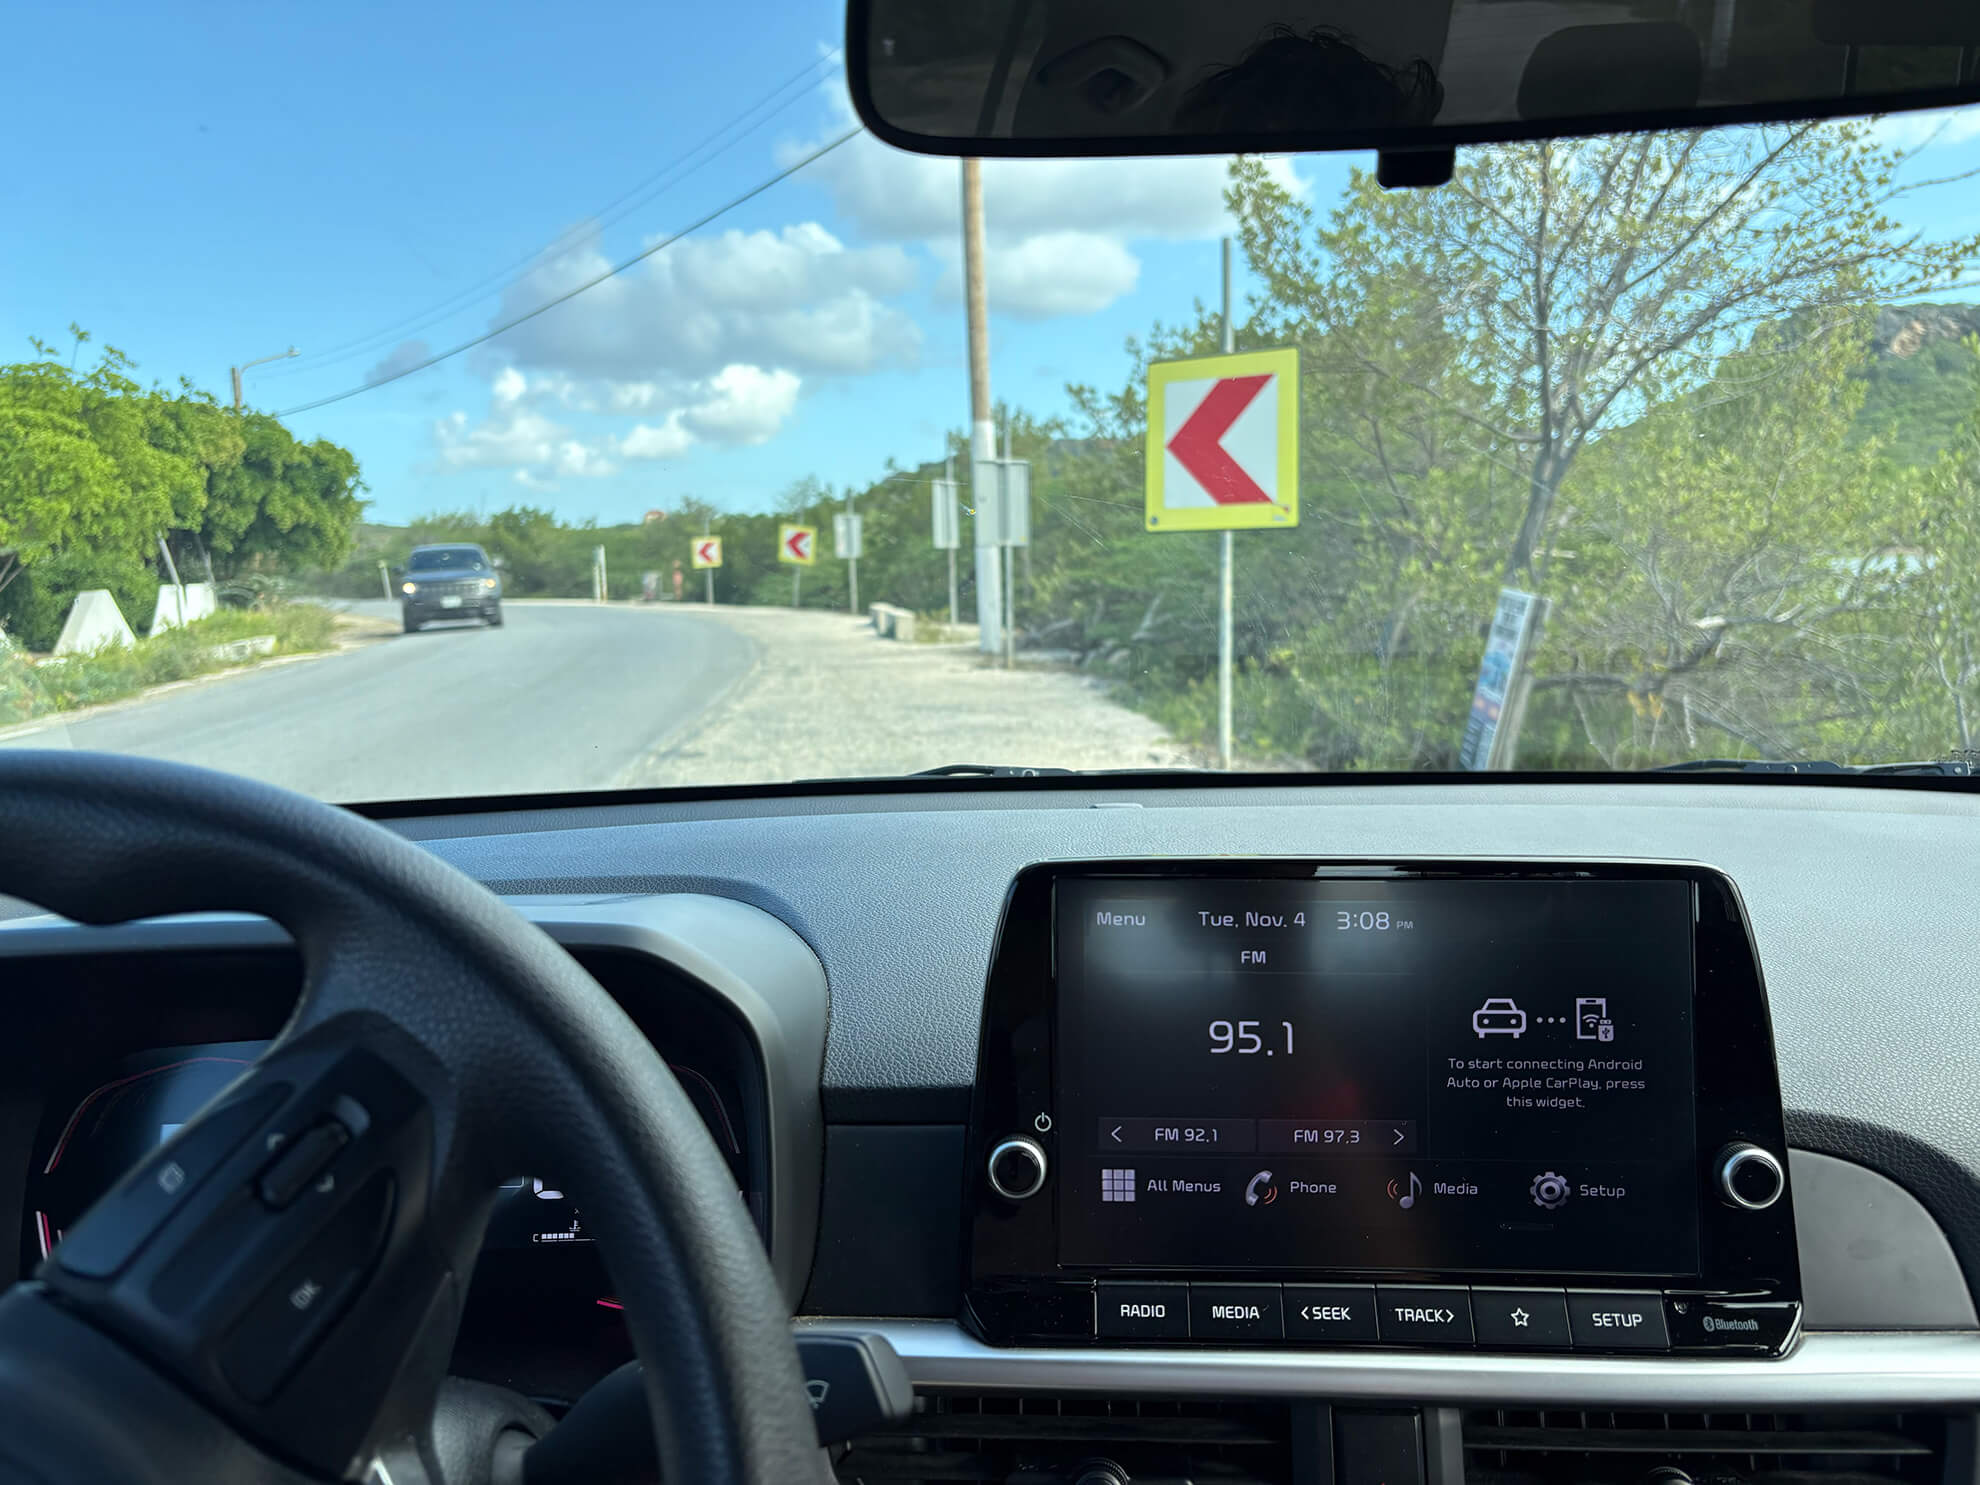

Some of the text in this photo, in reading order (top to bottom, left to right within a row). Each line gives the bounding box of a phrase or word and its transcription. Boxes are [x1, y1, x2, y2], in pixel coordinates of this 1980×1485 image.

[1096, 911, 1146, 927] Menu
[1197, 911, 1306, 928] Tue. Nov. 4
[1337, 911, 1414, 930] 3:08 PM
[1240, 950, 1266, 964] FM
[1208, 1020, 1293, 1056] 95.1
[1447, 1057, 1643, 1072] To start connecting Android
[1446, 1076, 1646, 1091] Auto or Apple CarPlay, press
[1506, 1095, 1585, 1110] this widget.
[1154, 1127, 1217, 1143] FM 92.1
[1294, 1129, 1360, 1144] FM 97.3
[1146, 1179, 1221, 1193] All Menus
[1290, 1181, 1337, 1194] Phone
[1433, 1182, 1478, 1195] Media
[1579, 1184, 1626, 1199] Setup
[1120, 1304, 1166, 1318] RADIO
[1212, 1305, 1260, 1319] MEDIA
[1592, 1312, 1643, 1327] SETUP
[1714, 1318, 1759, 1331] Bluetooth
